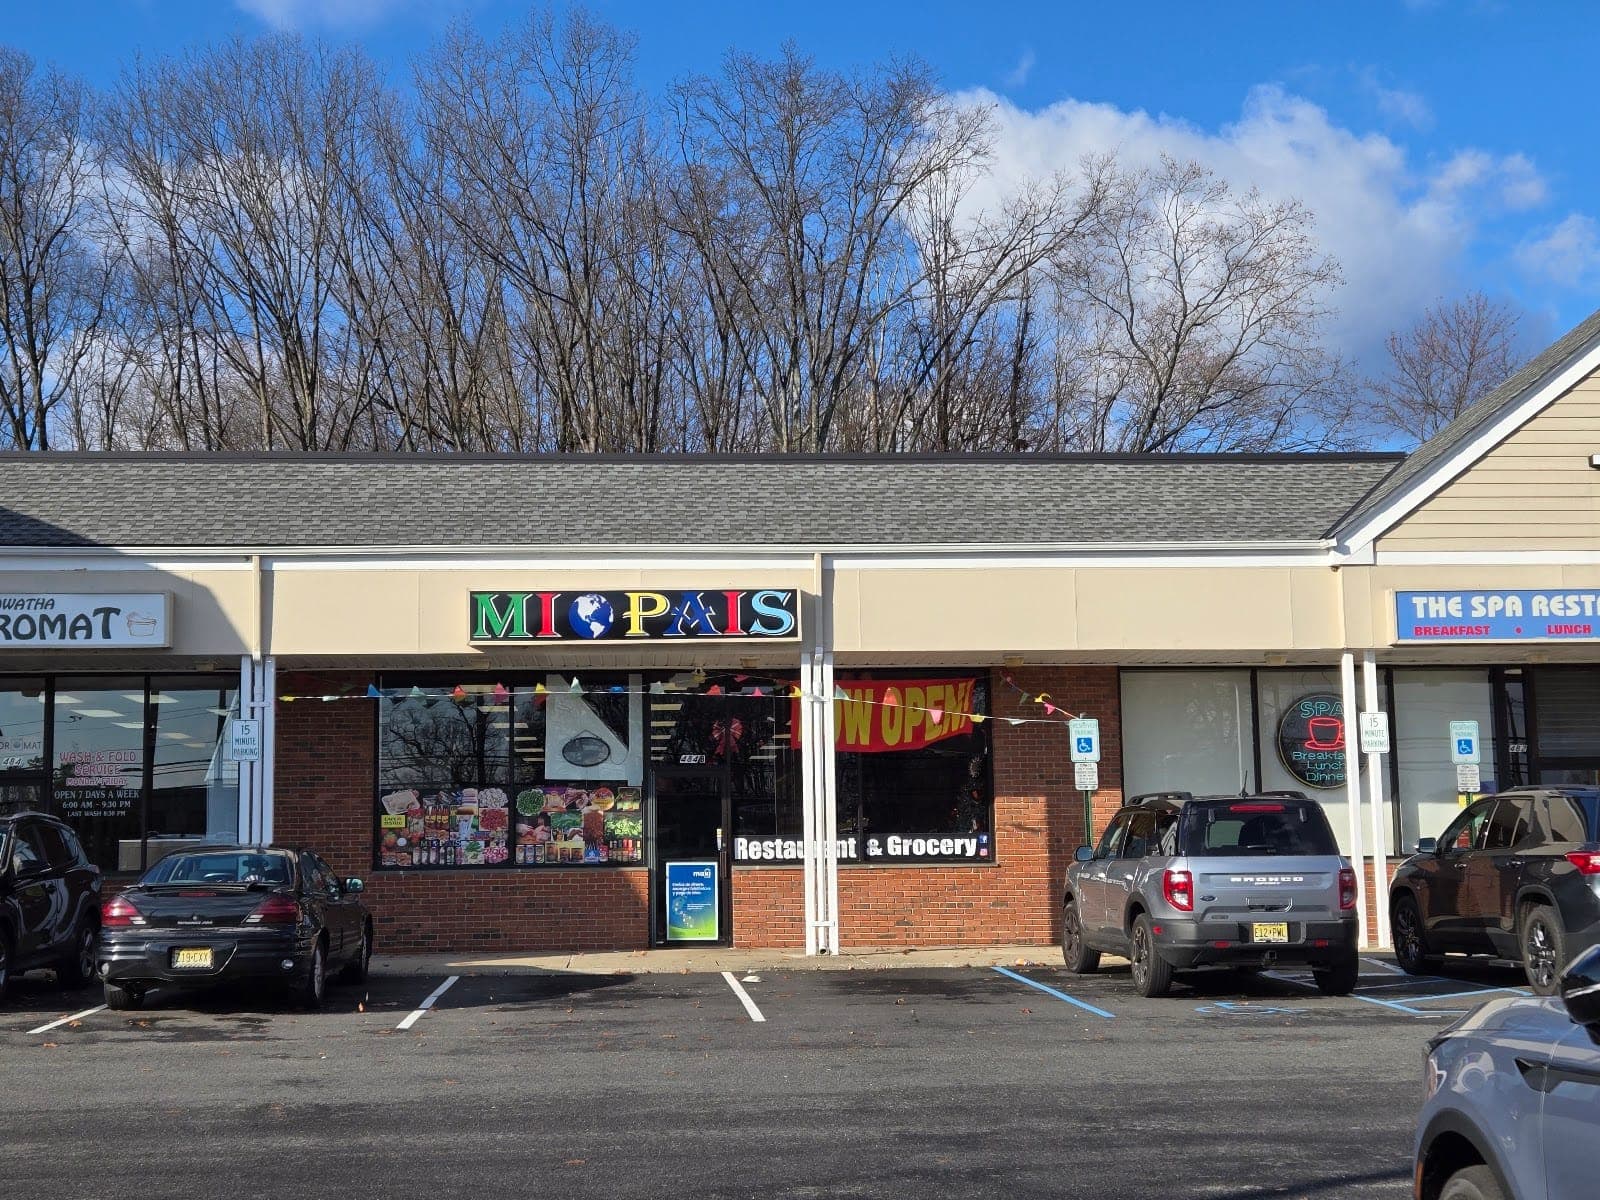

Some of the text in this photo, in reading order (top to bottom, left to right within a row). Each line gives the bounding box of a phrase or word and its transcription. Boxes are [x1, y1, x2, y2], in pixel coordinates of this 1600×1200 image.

[0, 598, 55, 610] WATHA
[1412, 594, 1600, 618] THE SPA REST
[472, 590, 796, 638] MI PAIS
[1414, 624, 1592, 636] BREAKFAST LUNCH
[1300, 701, 1345, 718] SPA
[1370, 718, 1378, 727] 15
[241, 724, 251, 735] 15
[1293, 751, 1345, 761] Breakfa
[1307, 772, 1345, 781] Dinne
[54, 790, 76, 799] OPEN
[86, 790, 106, 799] DAYS
[108, 791, 114, 799] A
[117, 790, 139, 799] WEEK
[867, 838, 883, 855] &
[887, 836, 978, 857] Grocery
